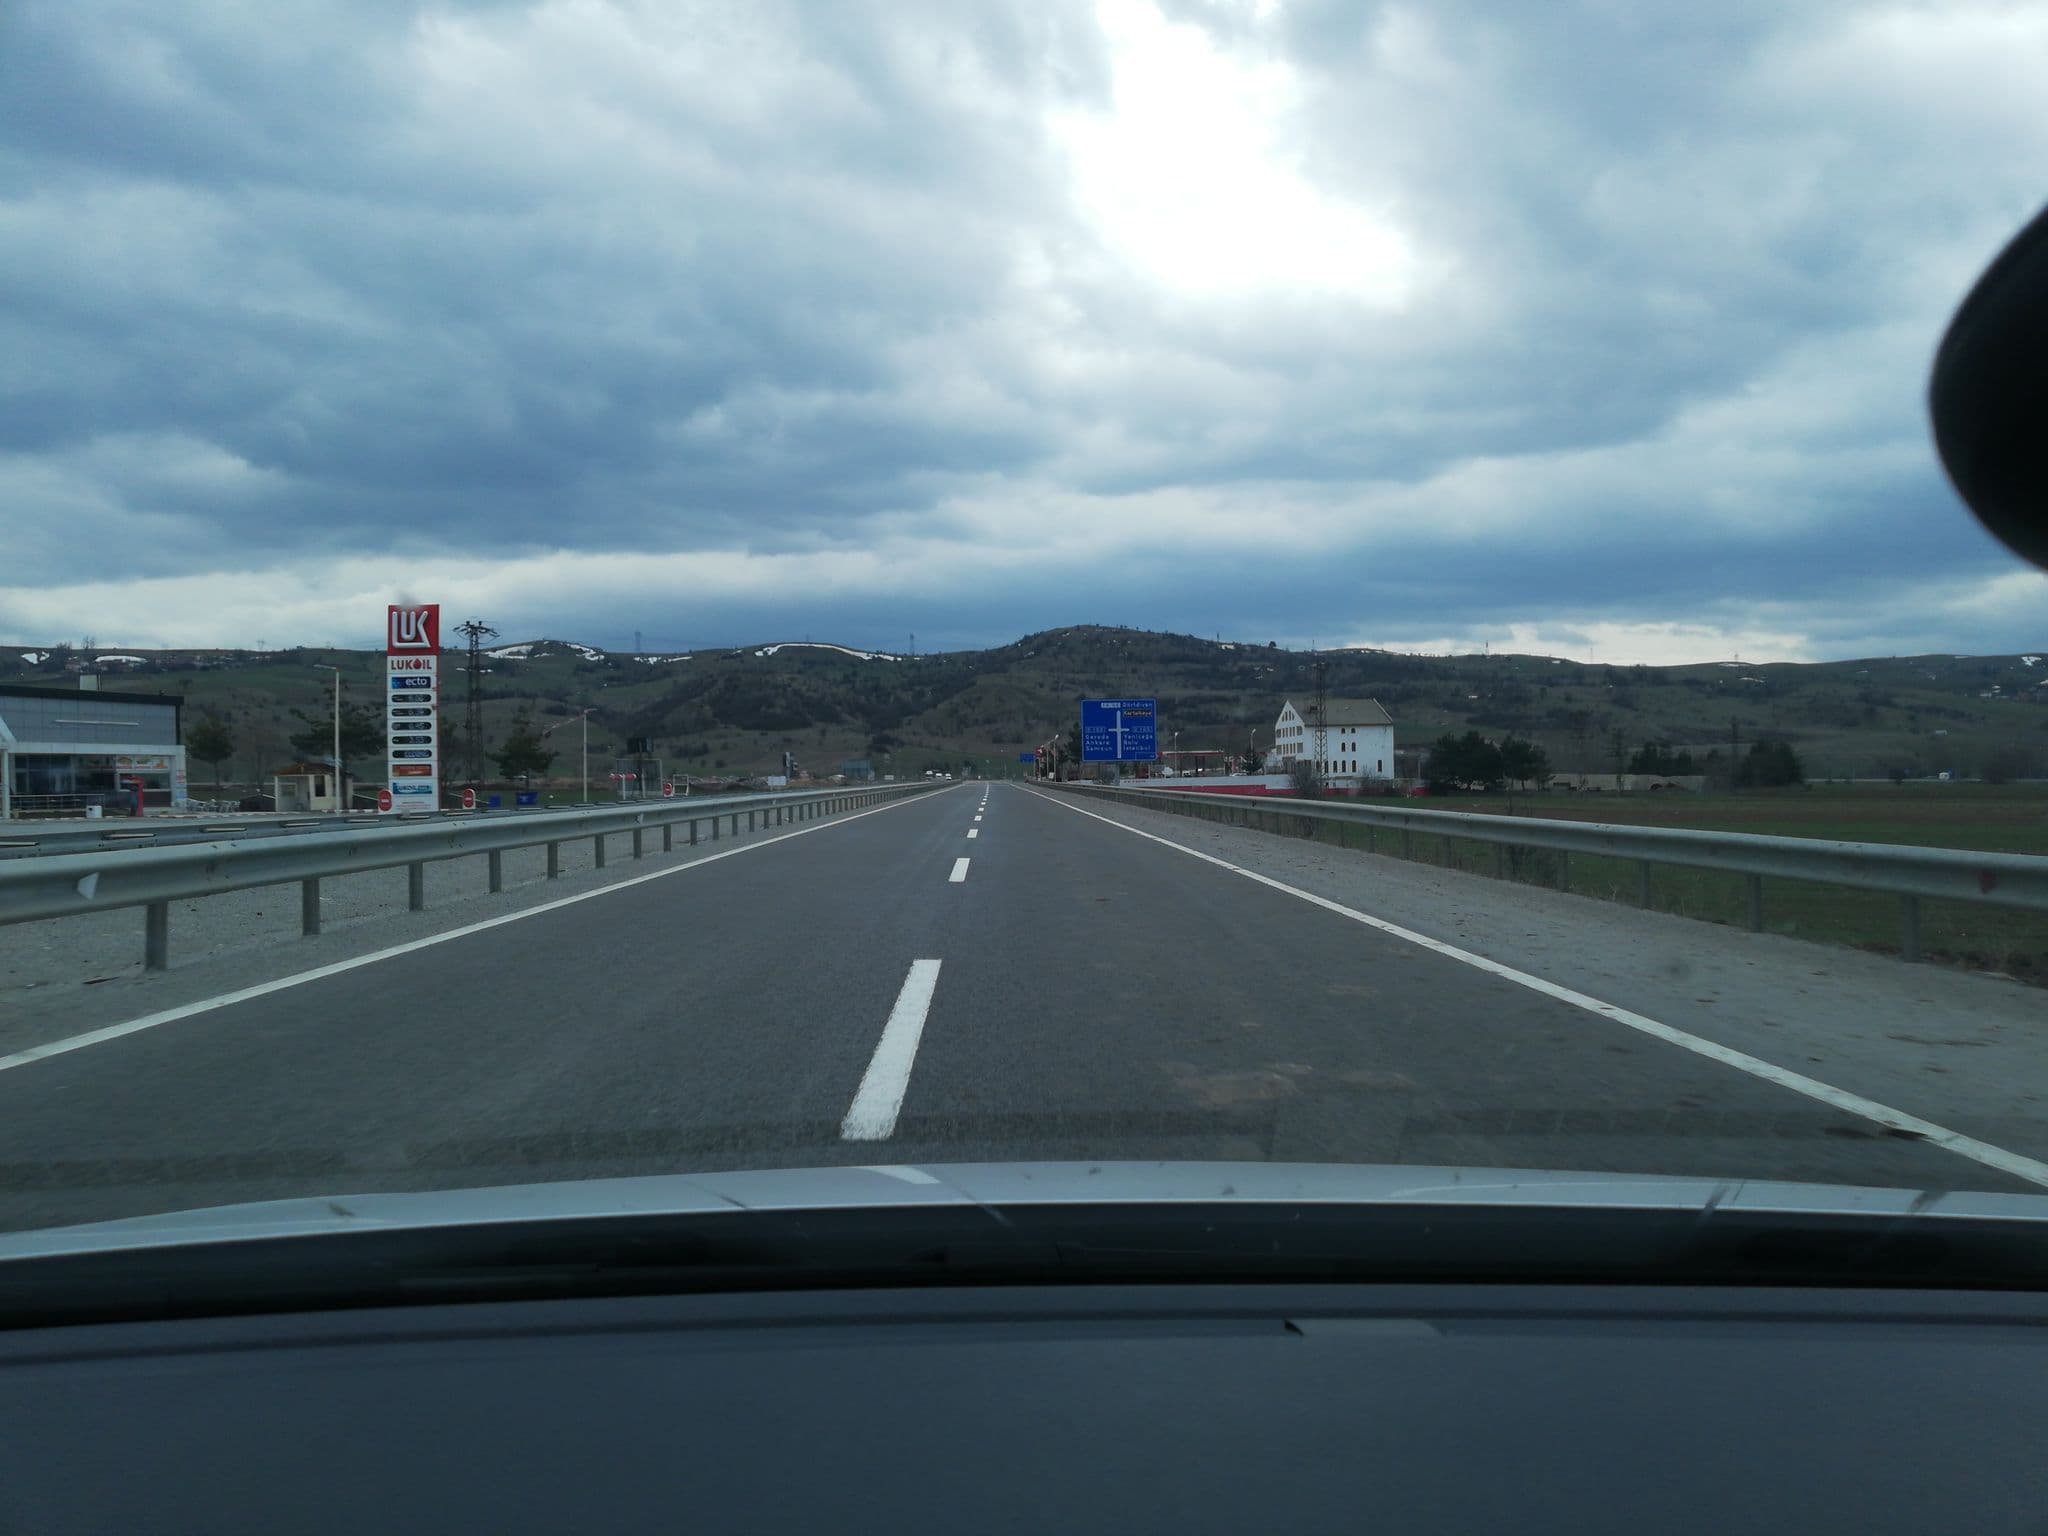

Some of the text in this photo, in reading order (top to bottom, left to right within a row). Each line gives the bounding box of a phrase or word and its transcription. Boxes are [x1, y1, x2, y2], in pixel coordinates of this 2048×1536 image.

[392, 611, 431, 648] LUK
[391, 658, 432, 670] LUKOIL
[405, 677, 428, 686] ecto
